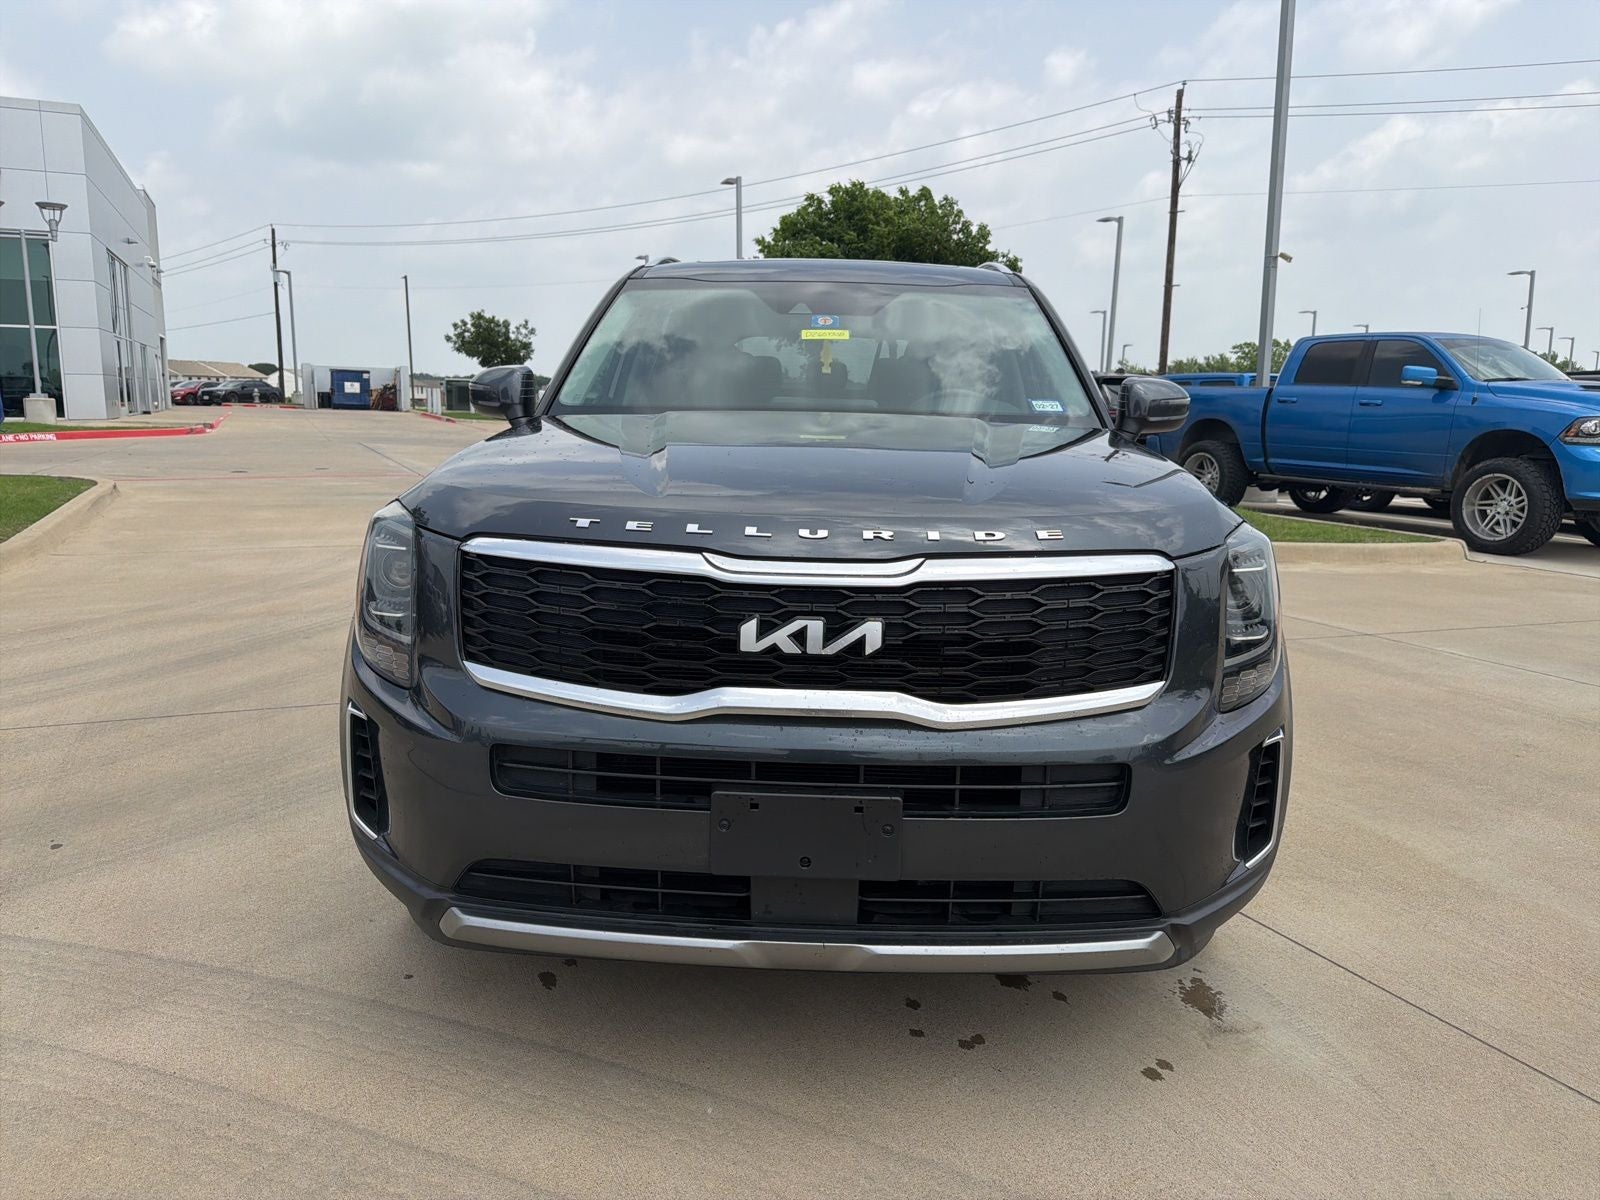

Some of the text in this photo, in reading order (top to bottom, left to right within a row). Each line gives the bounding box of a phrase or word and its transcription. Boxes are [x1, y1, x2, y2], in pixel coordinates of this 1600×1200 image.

[20, 433, 29, 441] NO
[30, 432, 57, 441] PARKING
[569, 517, 1064, 542] TELLURIDE
[738, 616, 884, 656] KIA
